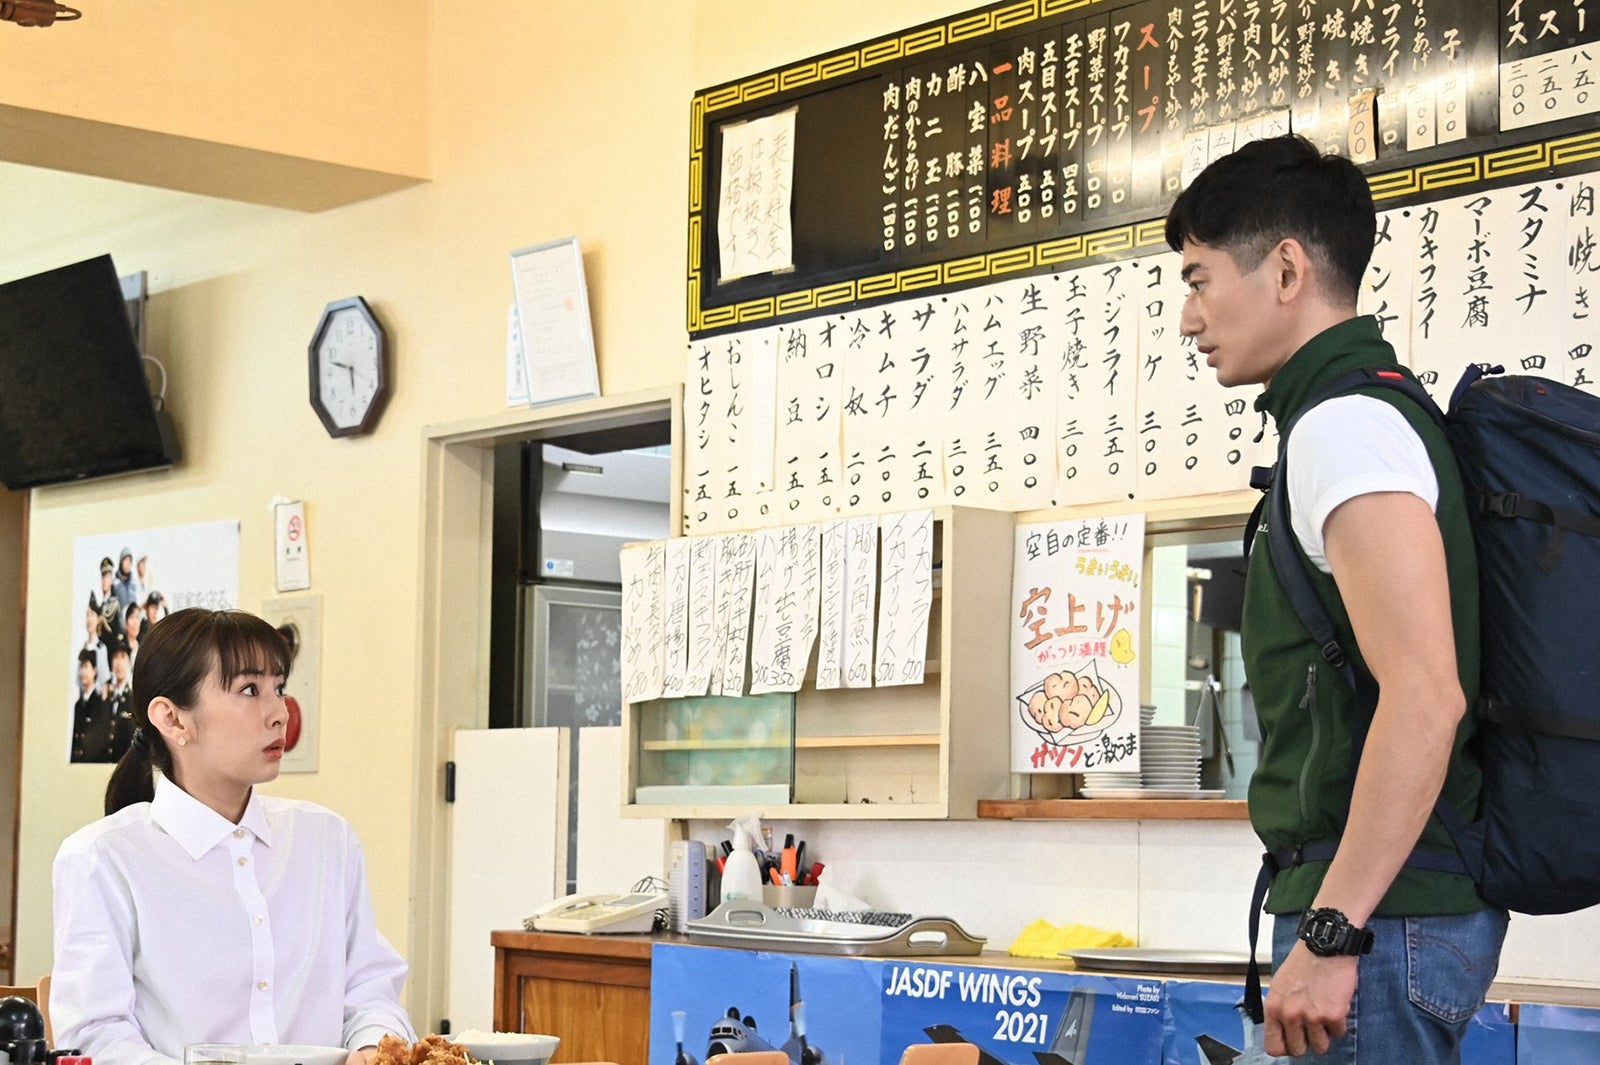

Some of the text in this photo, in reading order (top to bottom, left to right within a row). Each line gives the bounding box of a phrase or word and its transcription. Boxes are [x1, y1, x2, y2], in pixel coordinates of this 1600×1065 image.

[1165, 7, 1184, 129] 肉入りもやし炒め
[1241, 0, 1262, 113] ラ肉入り炒め
[1321, 8, 1347, 90] 焼き
[1381, 0, 1402, 78] フライ
[1573, 0, 1586, 32] ー
[905, 76, 921, 191] 肉のからあげ
[924, 72, 943, 185] カニ玉
[945, 63, 966, 178] 酢豚
[966, 61, 989, 176] 八宝菜
[1016, 46, 1036, 161] 肉スープ
[1039, 40, 1059, 158] 五目スープ
[1063, 33, 1082, 150] 玉子スープ
[1086, 27, 1106, 147] 野菜スープ
[1111, 21, 1131, 141] ワカメスープ
[1136, 23, 1159, 134] スープ
[883, 82, 900, 195] 肉だんご
[990, 62, 1013, 215] 一品料理
[1417, 207, 1439, 340] カキフライ
[1460, 196, 1494, 329] マーボ豆腐
[1515, 186, 1549, 315] スタミナ
[785, 328, 807, 425] 納豆
[816, 320, 837, 422] オロシ
[844, 318, 871, 416] 冷奴
[875, 310, 897, 418] キムチ
[910, 302, 937, 411] サラダ
[949, 302, 970, 411] ハムサラダ
[983, 294, 1006, 401] ハムエッグ
[1018, 282, 1048, 401] 生野菜
[1061, 274, 1088, 400] 玉子焼き
[1102, 265, 1126, 396] アジフライ
[1144, 264, 1165, 382] コロッケ
[698, 346, 713, 450] オヒタシ
[726, 339, 744, 443] おしんこ
[906, 511, 933, 657] イカフライ
[1020, 586, 1135, 650] 空上げ
[885, 966, 1042, 1008] JASDF WINGS
[993, 1010, 1048, 1045] 2021
[1153, 985, 1160, 995] by
